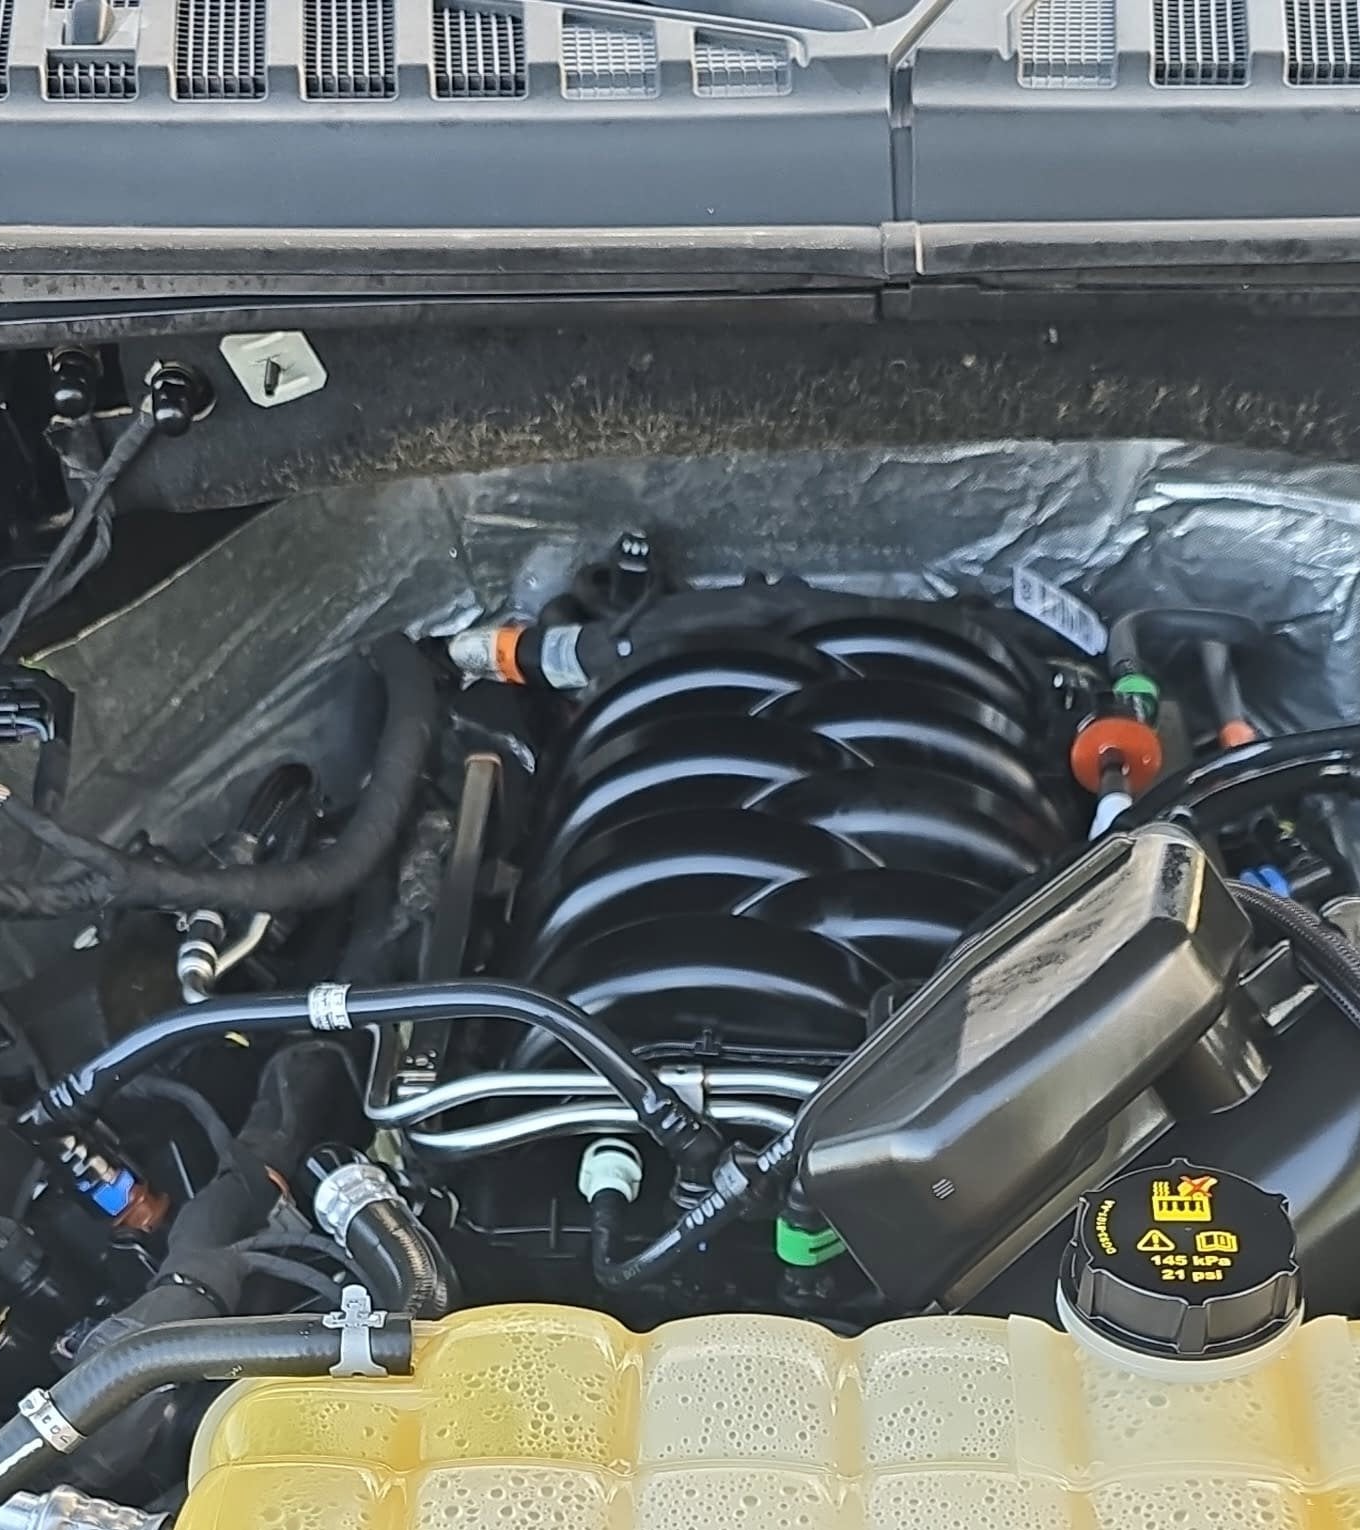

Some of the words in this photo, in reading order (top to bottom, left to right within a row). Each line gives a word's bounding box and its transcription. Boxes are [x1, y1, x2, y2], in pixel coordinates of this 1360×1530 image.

[1151, 1255, 1188, 1267] 145
[1193, 1255, 1232, 1267] kPa
[1162, 1269, 1186, 1281] 21
[1192, 1269, 1223, 1282] psi
